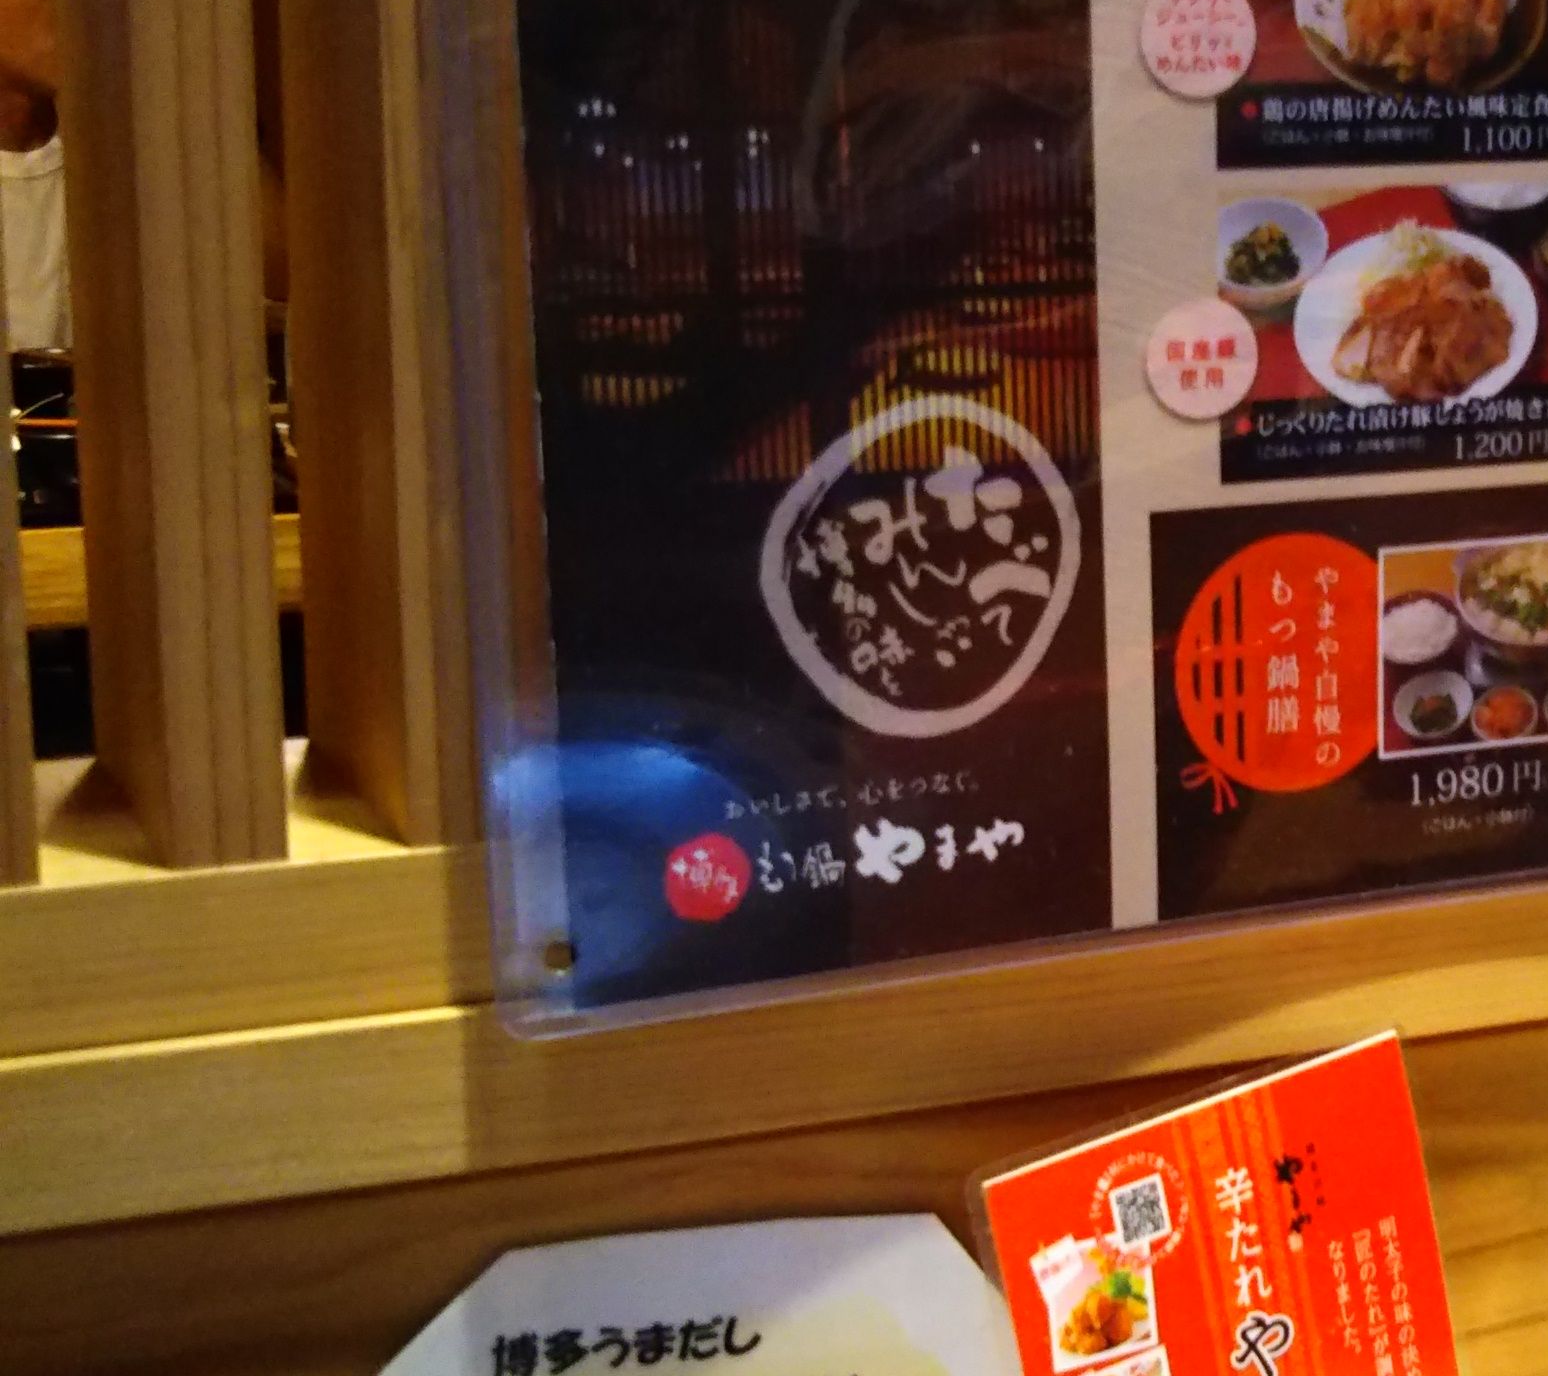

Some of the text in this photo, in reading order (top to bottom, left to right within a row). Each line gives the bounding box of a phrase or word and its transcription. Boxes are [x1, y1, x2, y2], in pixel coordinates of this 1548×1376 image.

[1265, 568, 1302, 736] もつ鍋膳
[1312, 563, 1344, 768] やまや自慢の
[1409, 756, 1544, 809] 1,980円
[1214, 1166, 1273, 1307] 辛たれ
